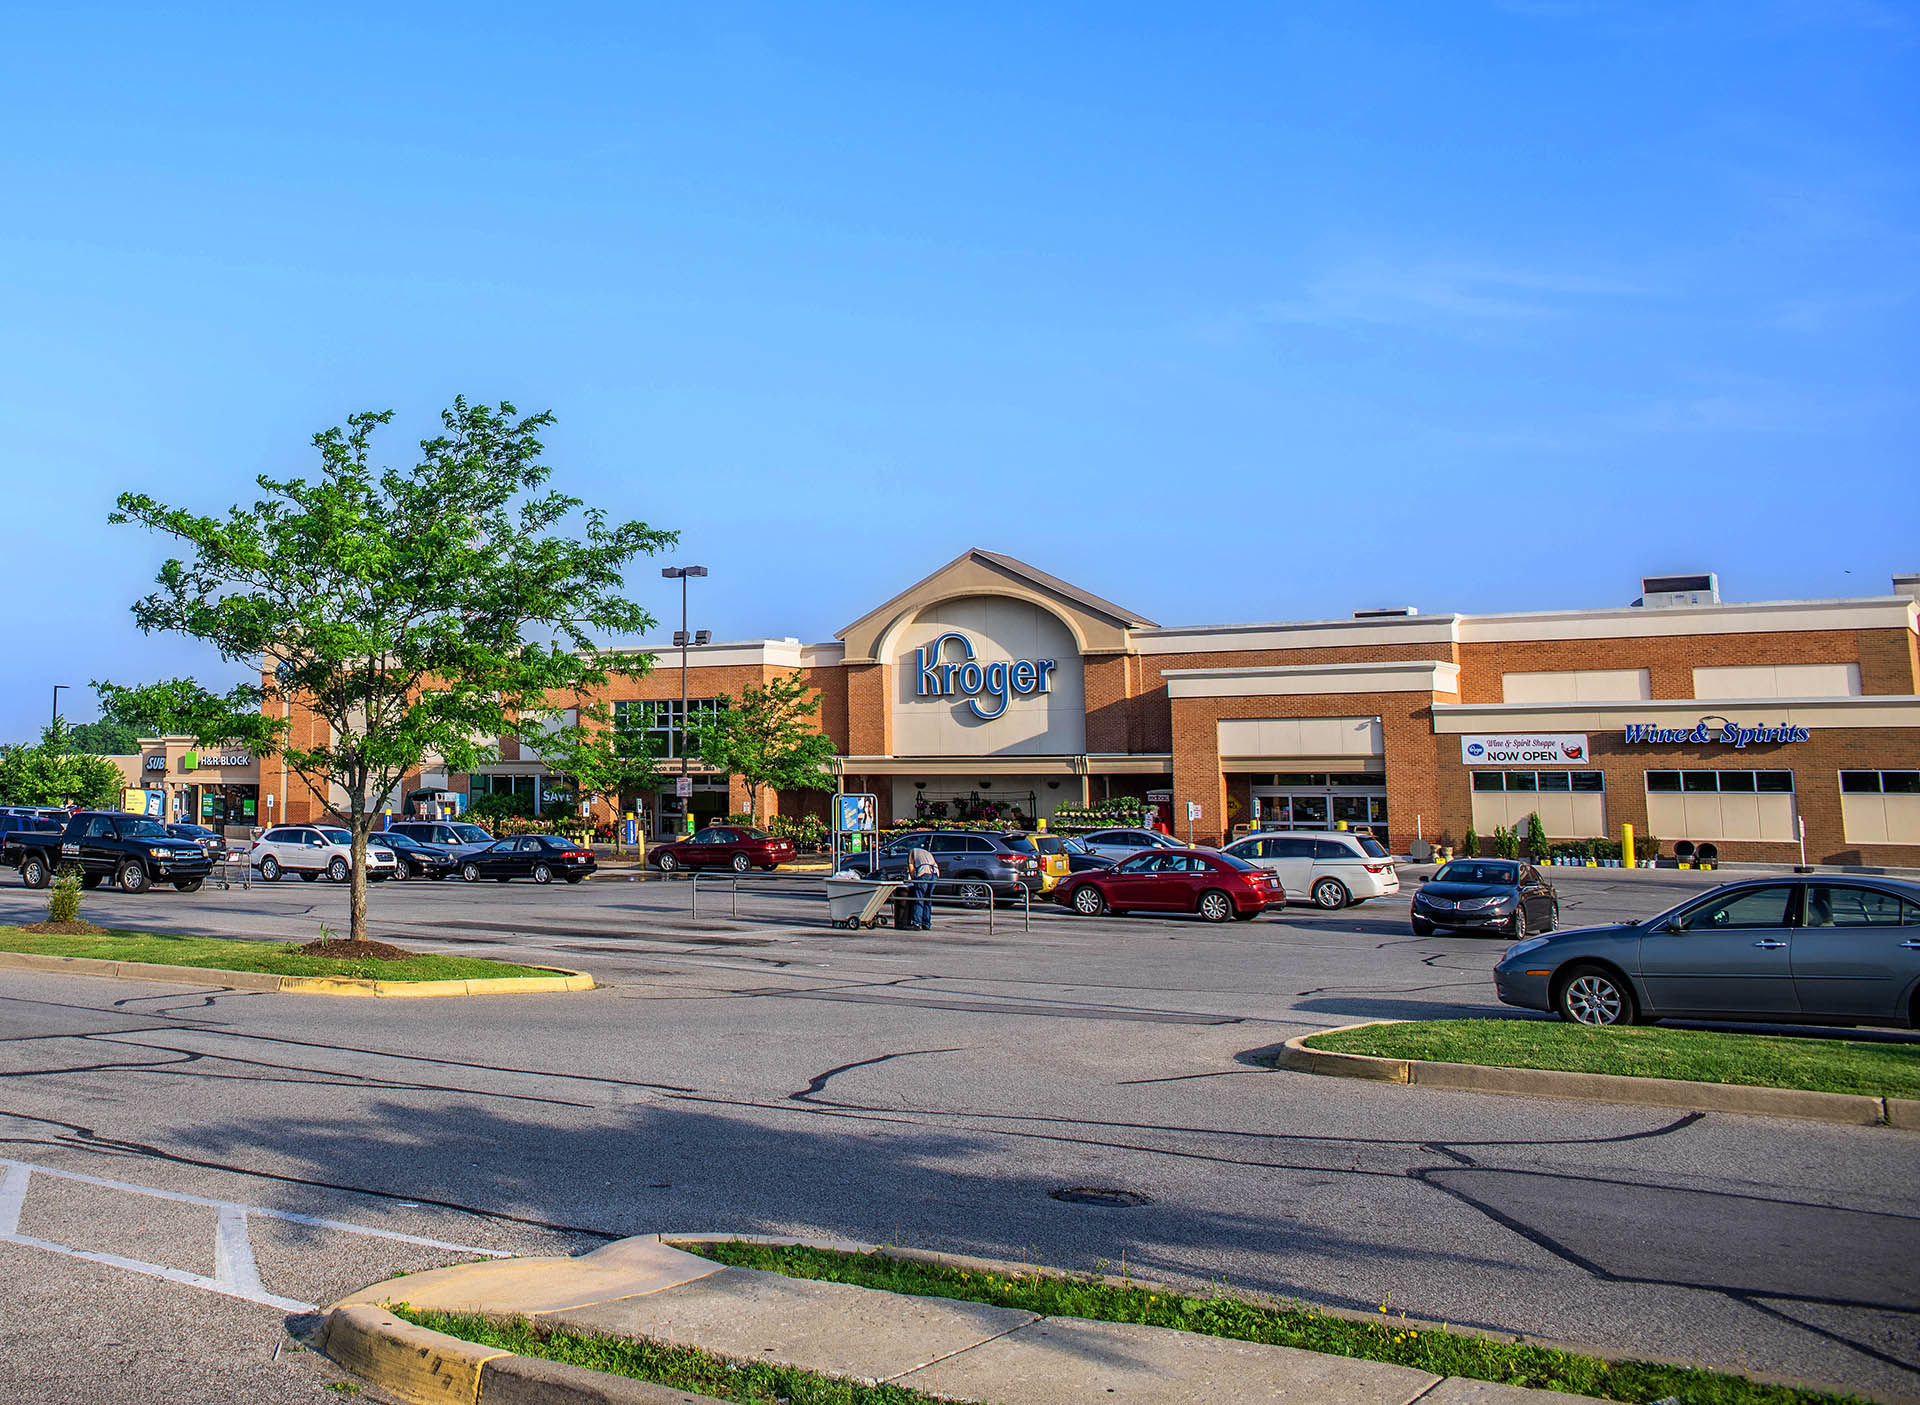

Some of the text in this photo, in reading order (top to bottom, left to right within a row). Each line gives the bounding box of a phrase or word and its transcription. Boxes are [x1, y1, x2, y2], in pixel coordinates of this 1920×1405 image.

[915, 631, 1056, 720] Kroger
[1720, 722, 1810, 748] Spirits
[1486, 739, 1555, 749] Wine & Spirit Shoppe
[201, 755, 249, 766] H&R BLOCK
[1487, 751, 1558, 761] NOW OPEN
[146, 757, 167, 770] SUB
